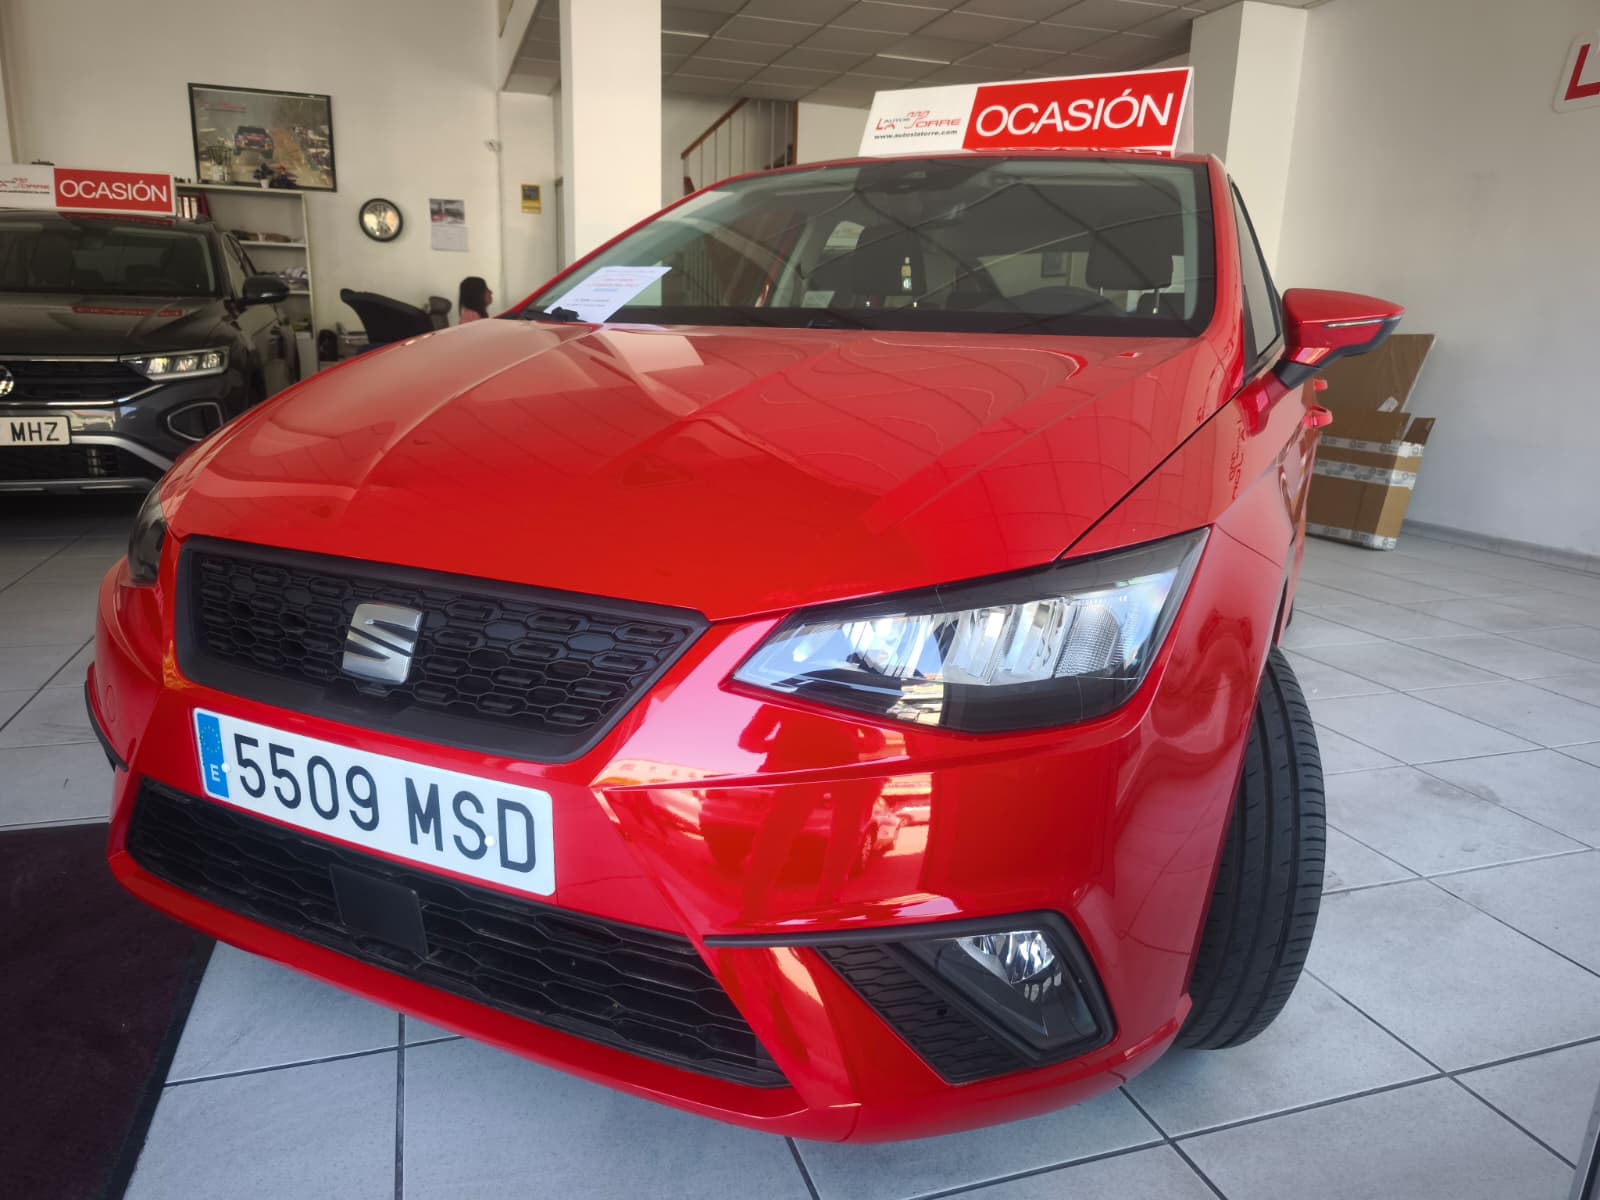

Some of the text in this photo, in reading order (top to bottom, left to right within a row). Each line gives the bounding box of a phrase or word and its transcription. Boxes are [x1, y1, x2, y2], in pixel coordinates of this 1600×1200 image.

[975, 88, 1174, 137] OCASIÓN
[59, 180, 168, 203] OCASIÓN
[10, 422, 60, 442] MHZ
[209, 763, 221, 783] E
[233, 733, 537, 874] 5509 MSD
